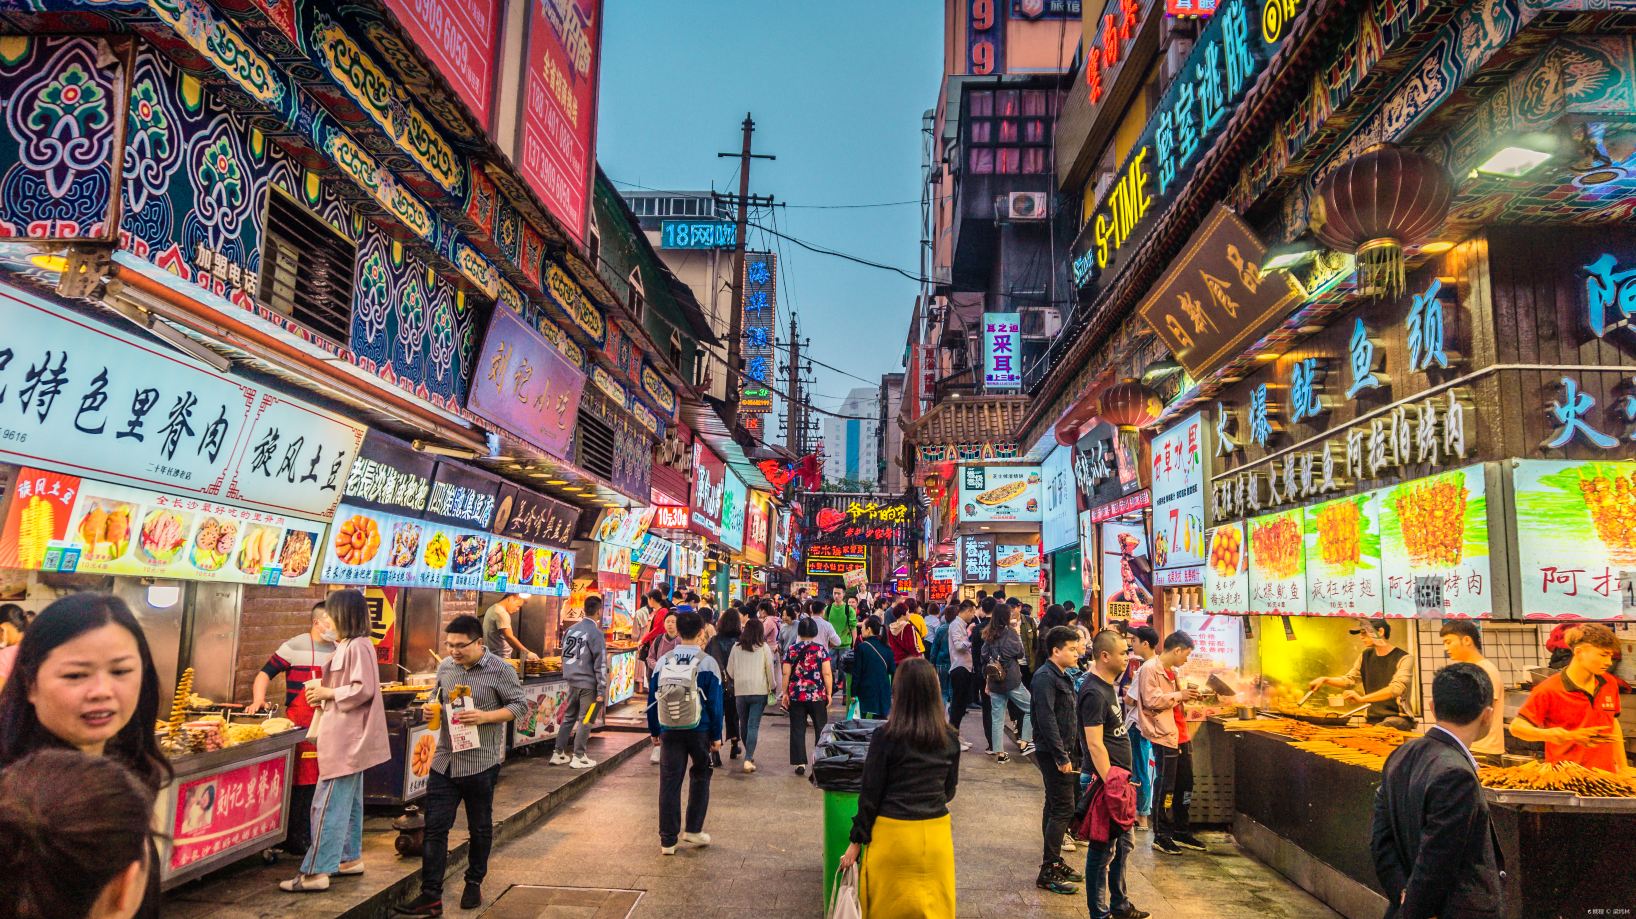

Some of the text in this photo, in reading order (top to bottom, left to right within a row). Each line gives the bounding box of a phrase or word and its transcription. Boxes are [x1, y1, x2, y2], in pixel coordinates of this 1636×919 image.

[443, 17, 468, 74] 6059
[1156, 0, 1254, 195] 密室逃脱
[1095, 146, 1151, 269] S-TIME
[196, 241, 258, 296] 加盟电话
[992, 334, 1012, 374] 采耳
[1549, 375, 1636, 449] 火
[251, 427, 347, 492] 旋风土豆
[18, 477, 75, 505] 旋风土豆
[156, 494, 286, 526] 全长沙最好吃的里脊肉
[1253, 583, 1300, 601] 火爆鱿鱼
[1311, 578, 1376, 601] 疯狂烤翅
[1388, 569, 1483, 600] 阿烤肉
[216, 768, 280, 817] 刘记里脊肉
